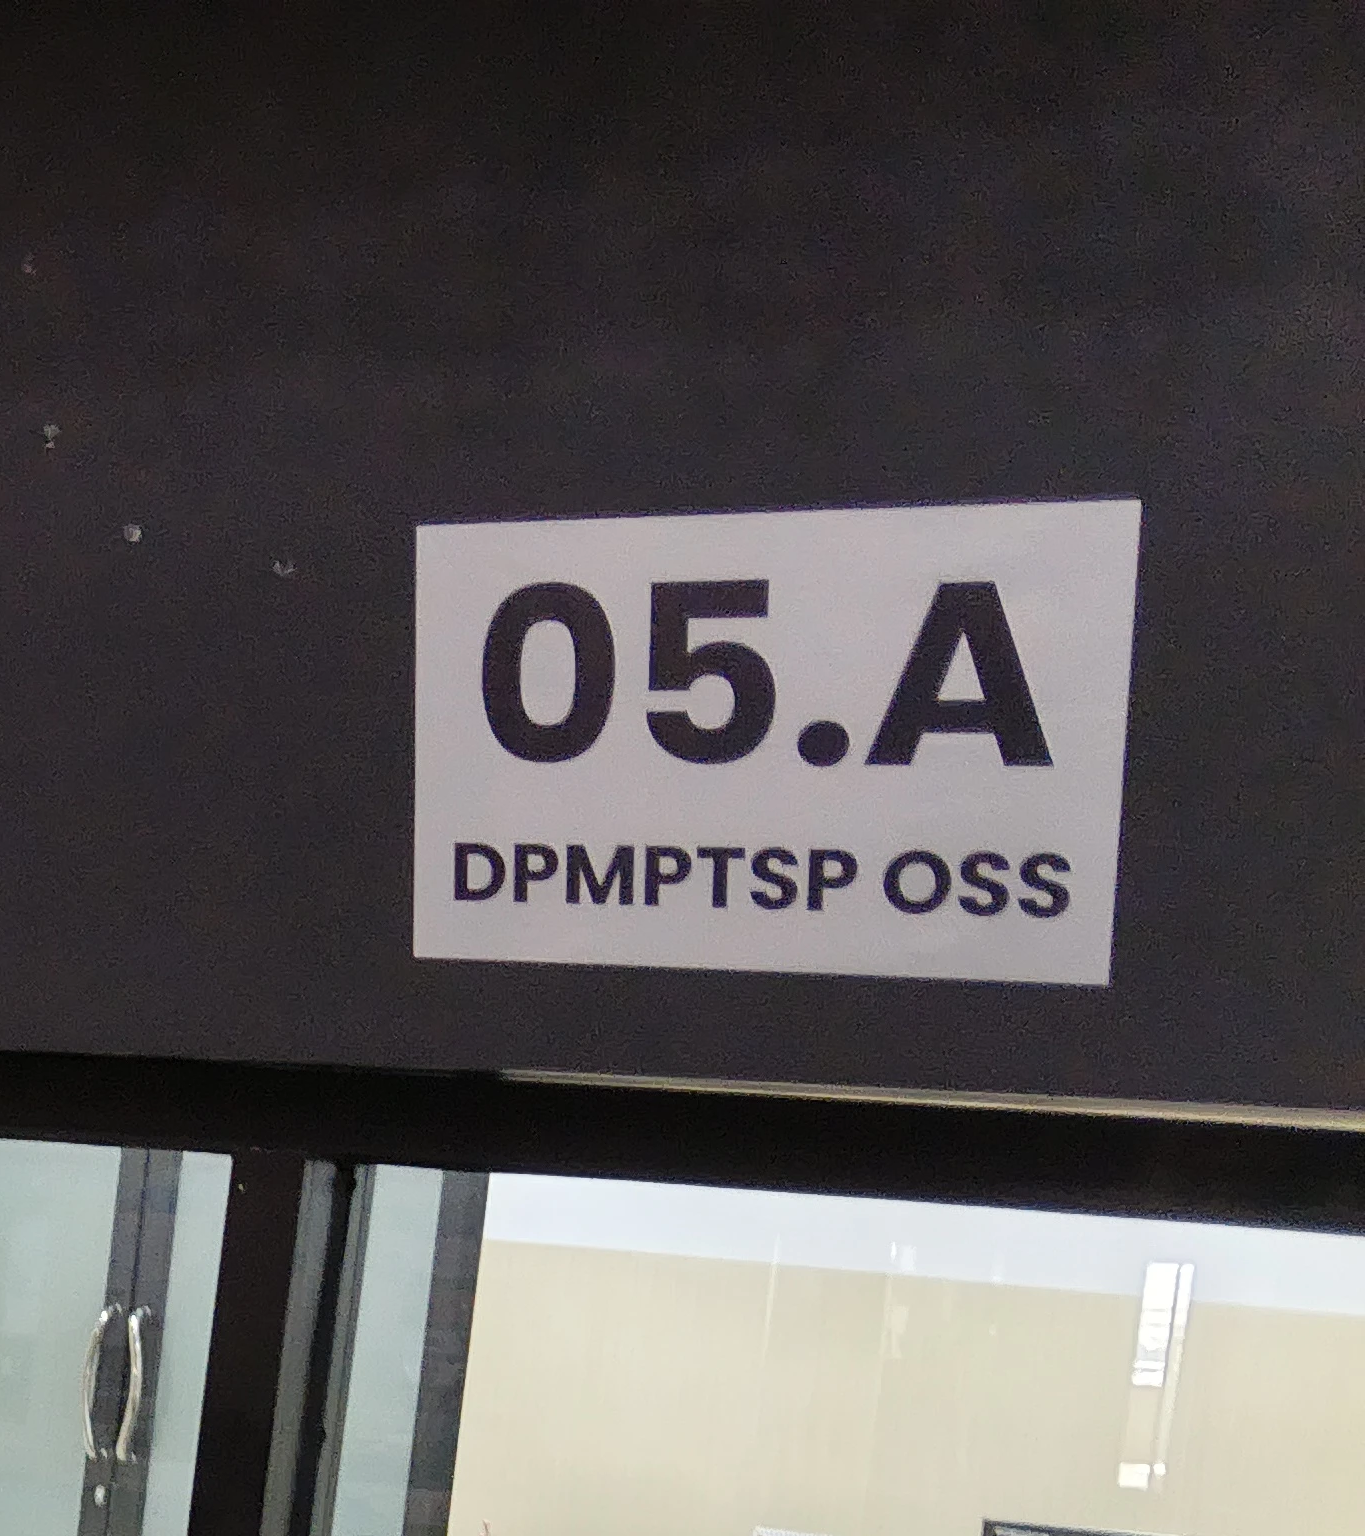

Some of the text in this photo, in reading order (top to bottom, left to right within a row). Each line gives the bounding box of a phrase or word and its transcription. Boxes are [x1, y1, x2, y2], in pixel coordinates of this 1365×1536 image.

[482, 579, 1055, 767] 05.A
[453, 841, 1072, 918] DPMPTSP OSS
